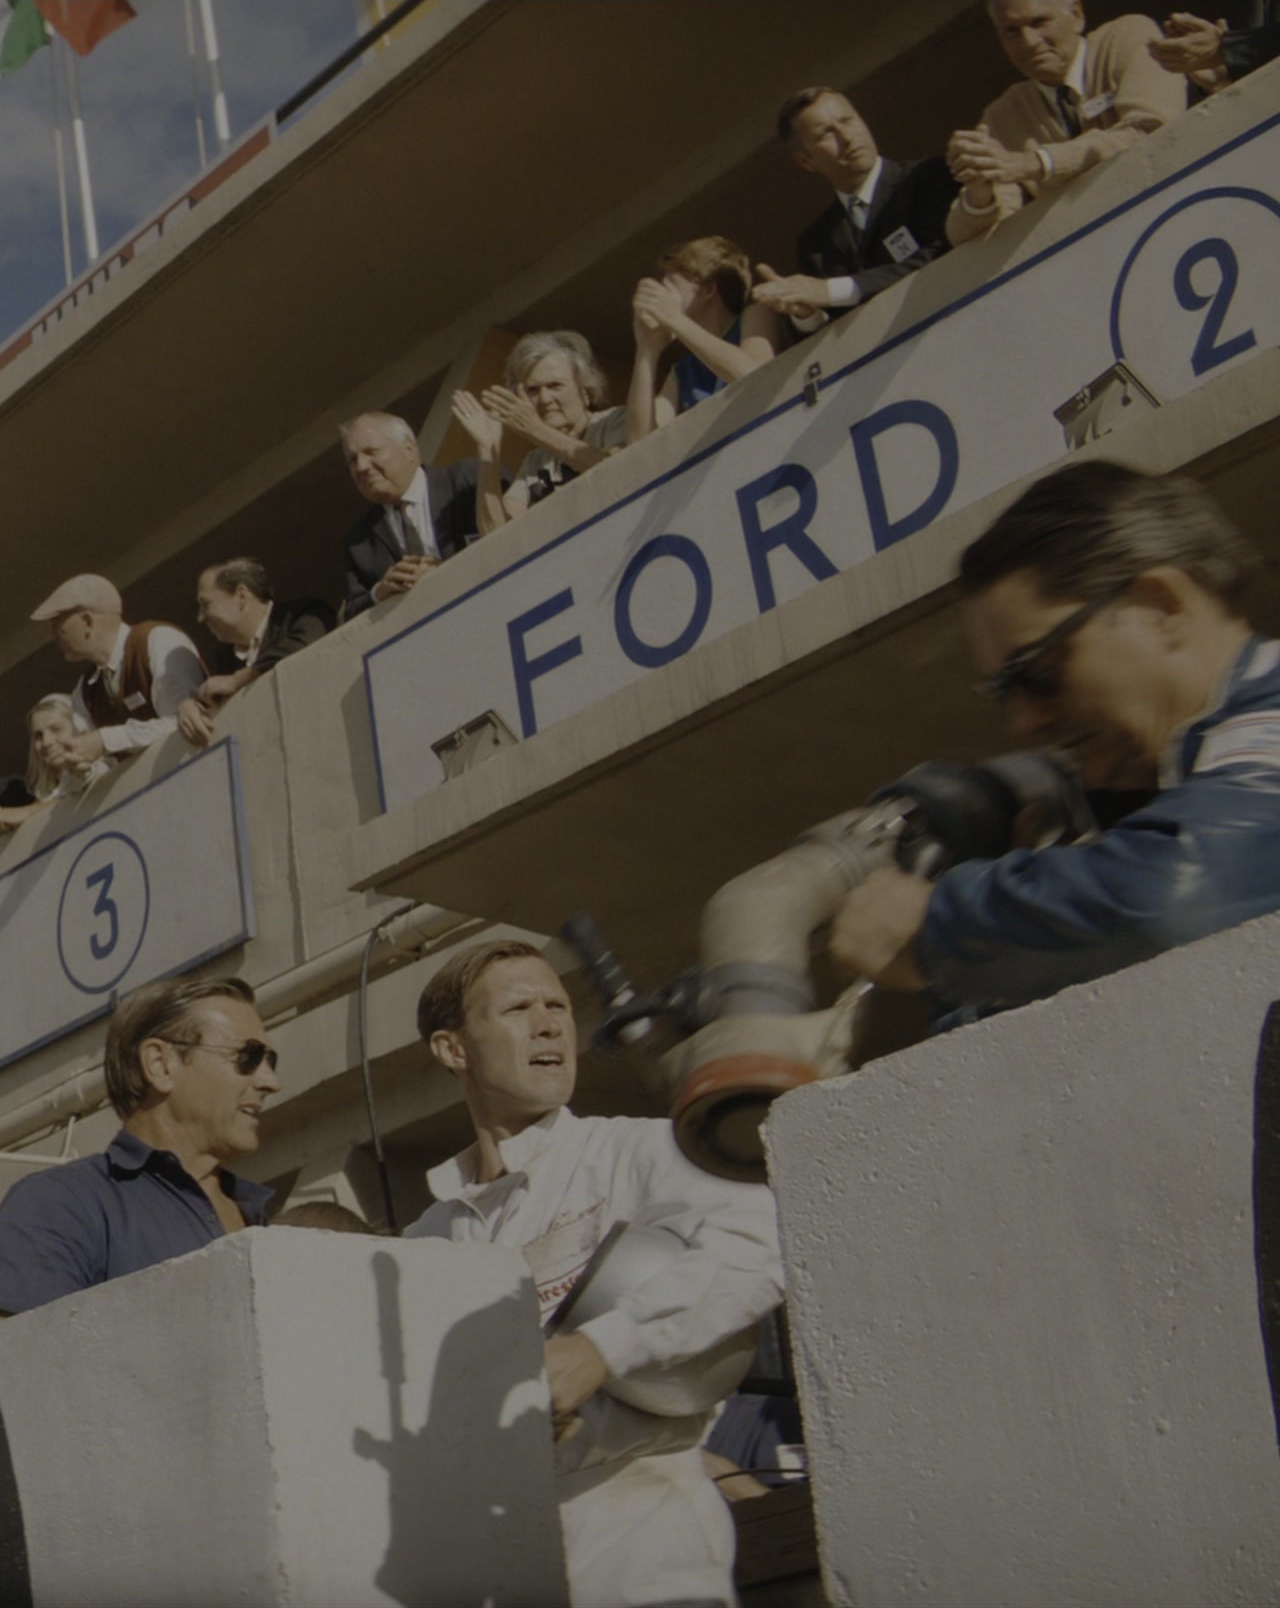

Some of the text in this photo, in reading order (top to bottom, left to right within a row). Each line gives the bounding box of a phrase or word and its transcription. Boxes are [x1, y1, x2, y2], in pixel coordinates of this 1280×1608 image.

[507, 238, 1256, 739] FORD 2
[85, 862, 119, 960] 3
